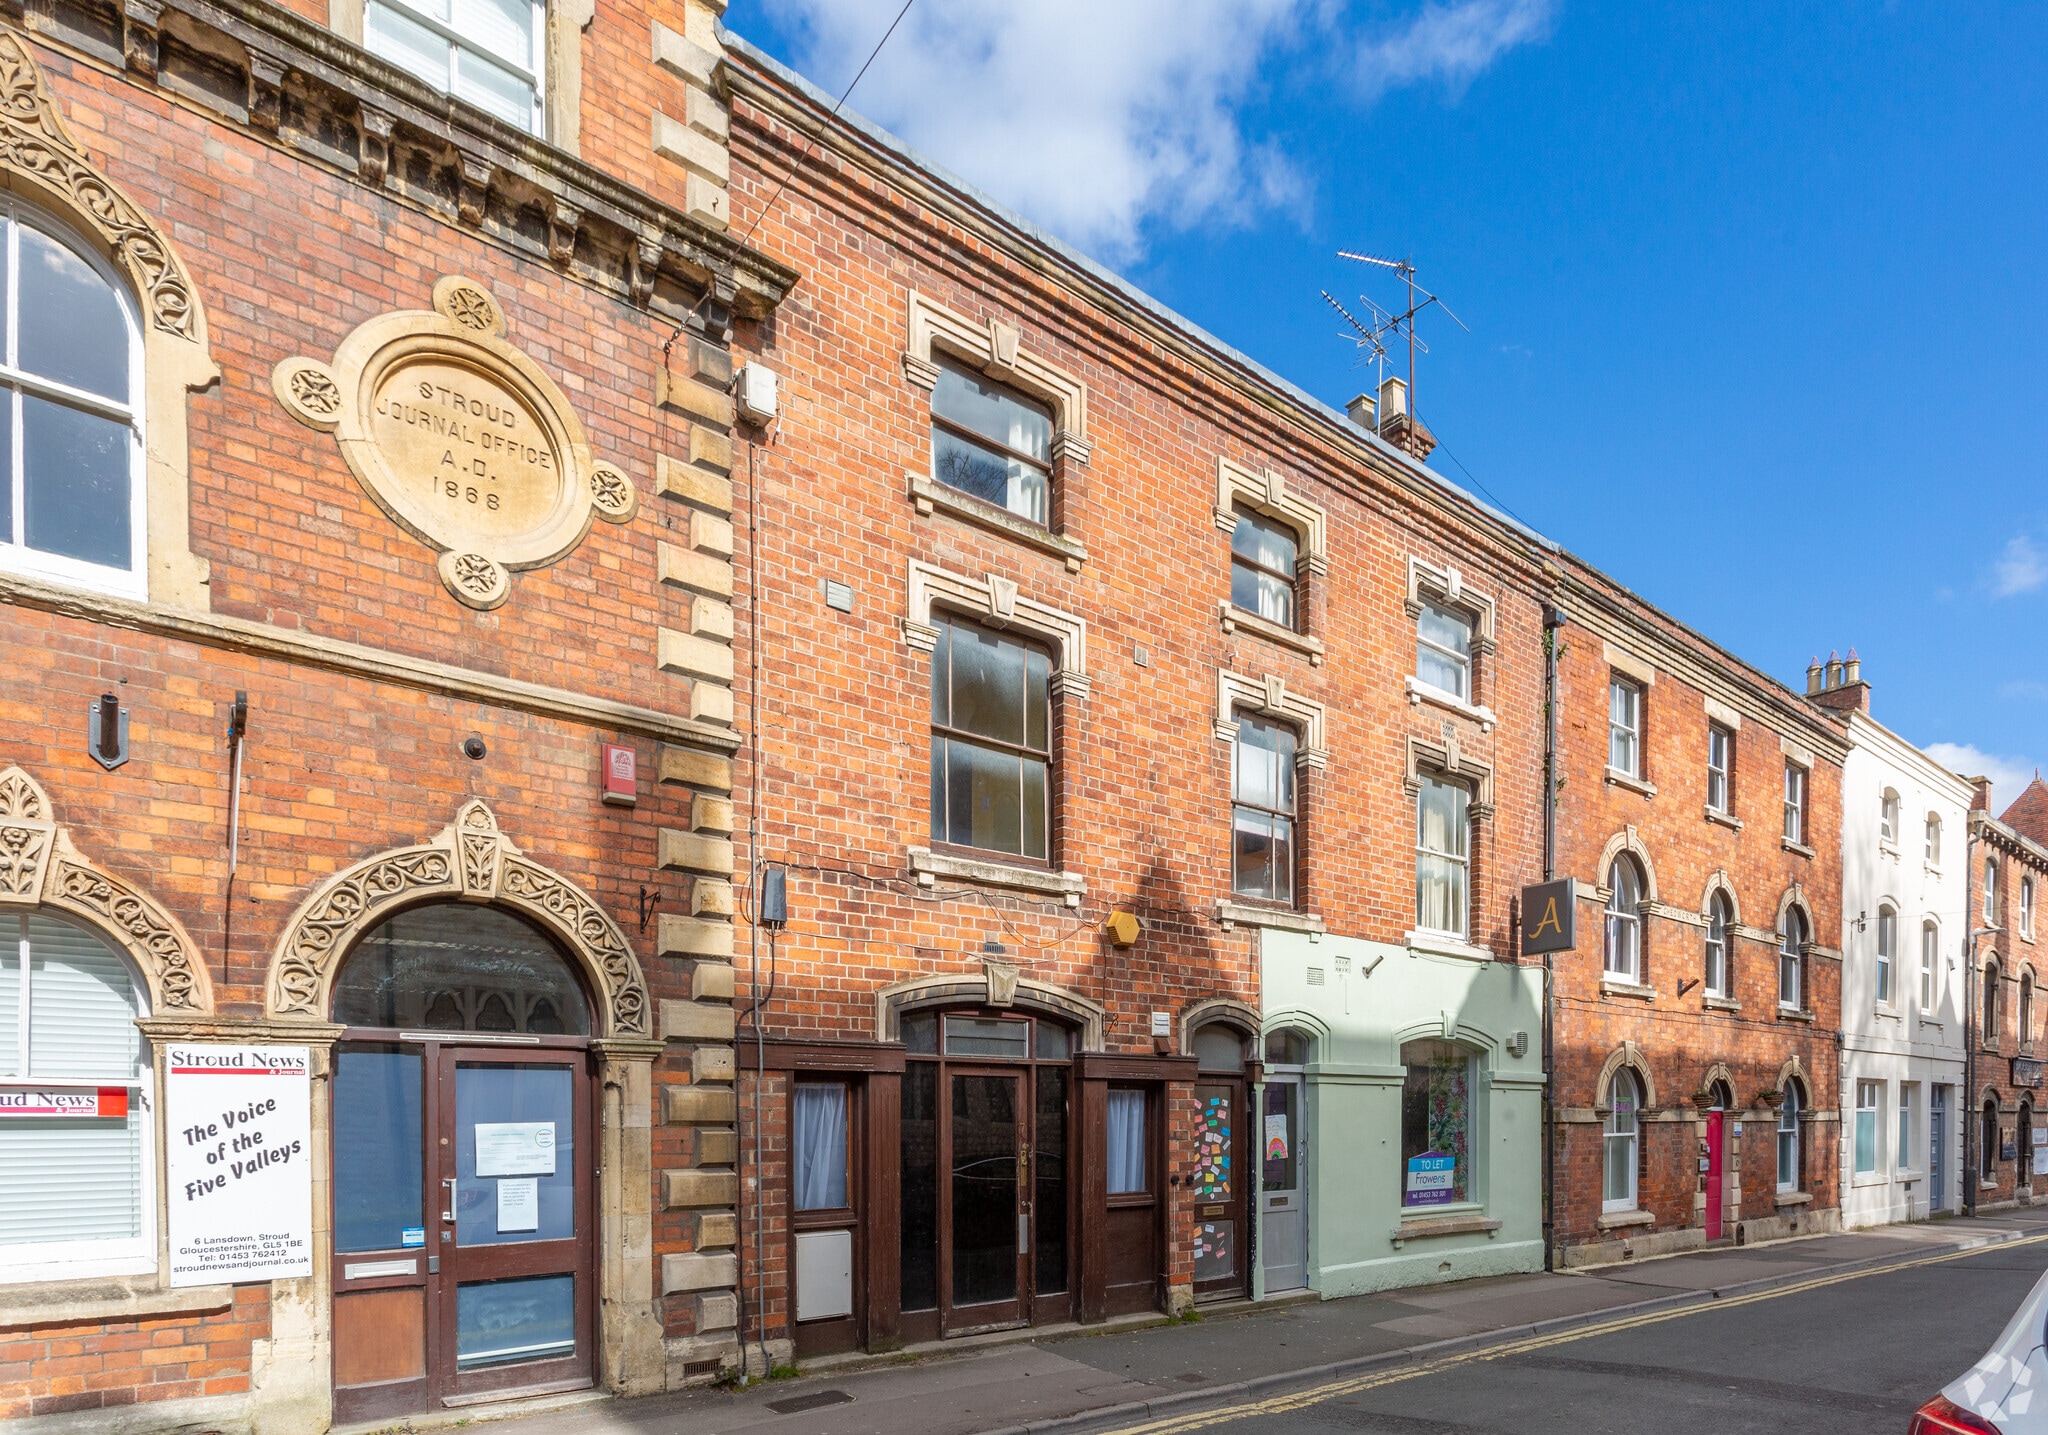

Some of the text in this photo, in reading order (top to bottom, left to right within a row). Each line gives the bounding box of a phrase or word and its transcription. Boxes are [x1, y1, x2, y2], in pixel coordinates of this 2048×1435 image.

[419, 382, 516, 428] STROUD
[377, 400, 550, 469] JOURNAL OFFICE
[441, 450, 496, 481] A.D.
[434, 476, 500, 510] 1868
[1528, 896, 1562, 938] A
[172, 1050, 304, 1067] Stroud News
[37, 1092, 95, 1106] News
[183, 1098, 276, 1145] The Voice
[206, 1132, 263, 1164] of the
[185, 1140, 301, 1201] Five Valleys
[1422, 1160, 1444, 1170] TO LET
[1416, 1173, 1446, 1184] Frowens
[259, 1232, 290, 1240] Stroud
[180, 1244, 260, 1254] Gloucestershire,
[219, 1252, 249, 1260] 01453
[252, 1250, 286, 1258] 762412
[174, 1256, 309, 1273] stroudnewsandjournal.co.uk
